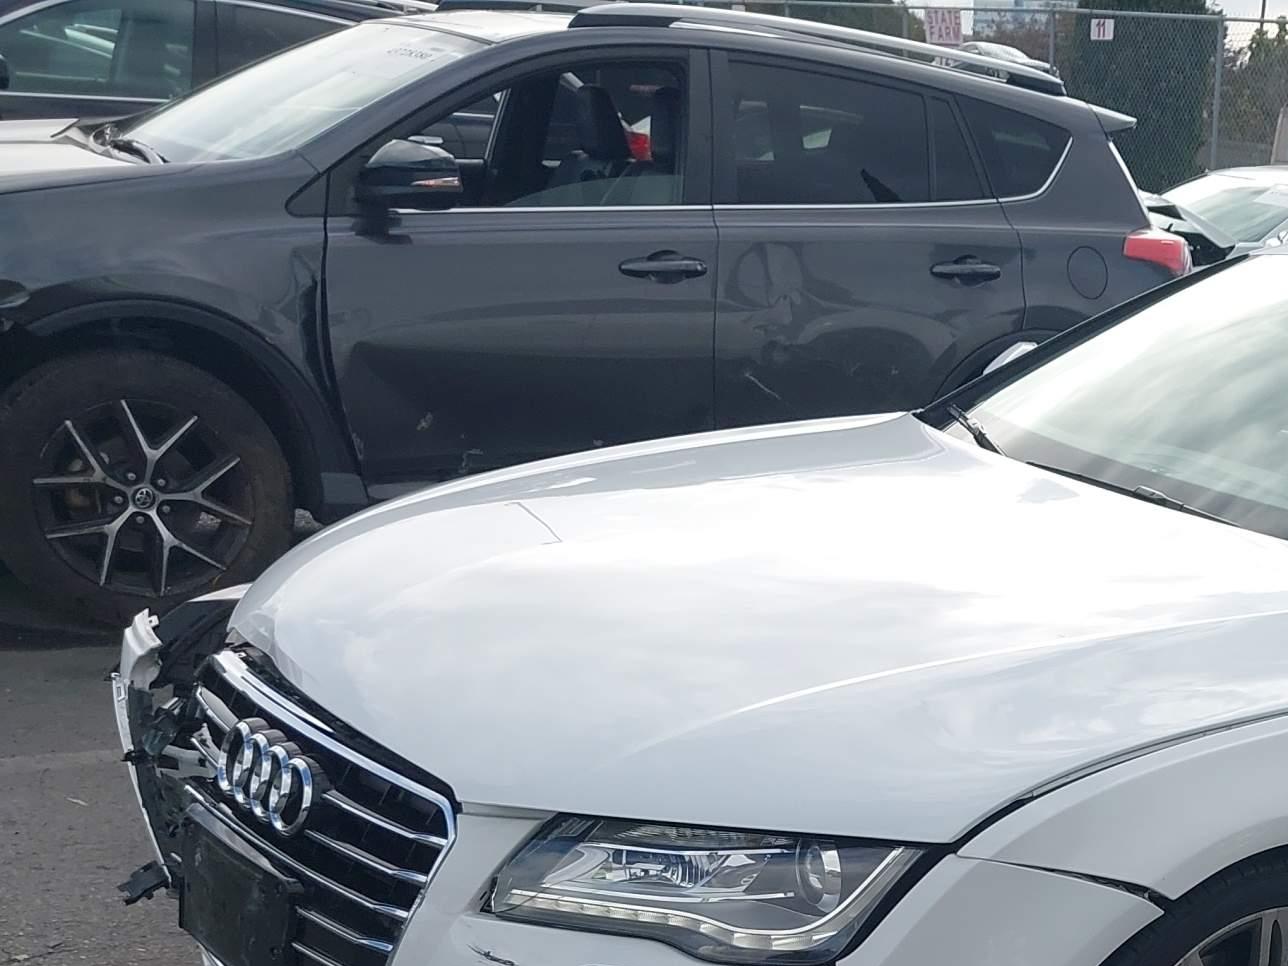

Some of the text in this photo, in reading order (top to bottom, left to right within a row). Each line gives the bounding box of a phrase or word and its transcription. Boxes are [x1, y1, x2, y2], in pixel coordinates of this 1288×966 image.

[928, 10, 960, 25] STATE
[930, 26, 960, 42] FARM
[1096, 19, 1106, 38] 11
